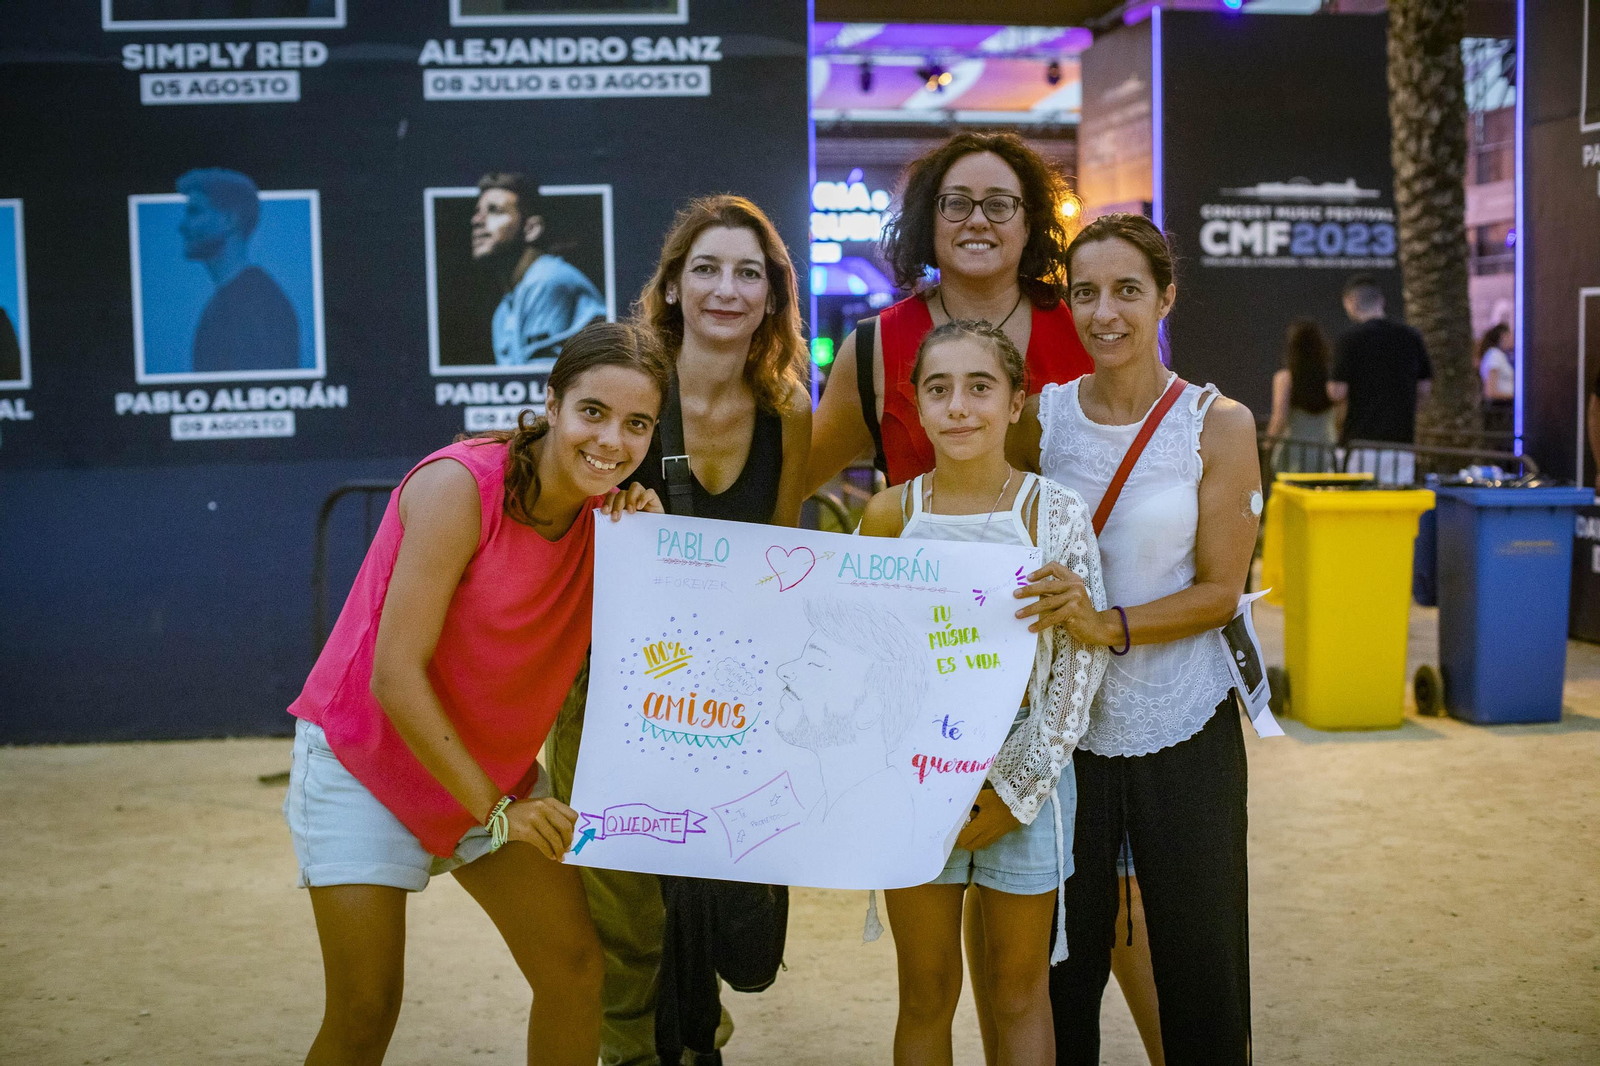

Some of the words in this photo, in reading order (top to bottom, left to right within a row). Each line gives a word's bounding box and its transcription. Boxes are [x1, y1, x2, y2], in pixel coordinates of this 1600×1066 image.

[121, 41, 252, 70] SIMPLY
[256, 40, 329, 69] RED
[418, 36, 628, 66] ALEJANDRO
[631, 36, 723, 62] SANZ
[151, 79, 182, 97] 05
[187, 77, 290, 96] AGOSTO
[431, 75, 463, 93] 08
[469, 75, 543, 92] JULIO
[567, 73, 598, 91] 03
[603, 71, 703, 90] AGOSTO
[1200, 219, 1396, 257] CMF2023
[115, 389, 210, 416] PABLO
[211, 381, 349, 411] ALBORÁN
[435, 381, 527, 406] PABLO
[656, 527, 731, 563] PABLO
[837, 547, 941, 583] ALBORÁN
[652, 575, 735, 594] #FOREVER
[928, 622, 983, 651] MÚSICA
[642, 640, 687, 669] 100%
[936, 656, 957, 675] ES
[964, 652, 1001, 671] VIDA
[932, 713, 965, 741] te
[605, 815, 683, 834] QUEDATE
